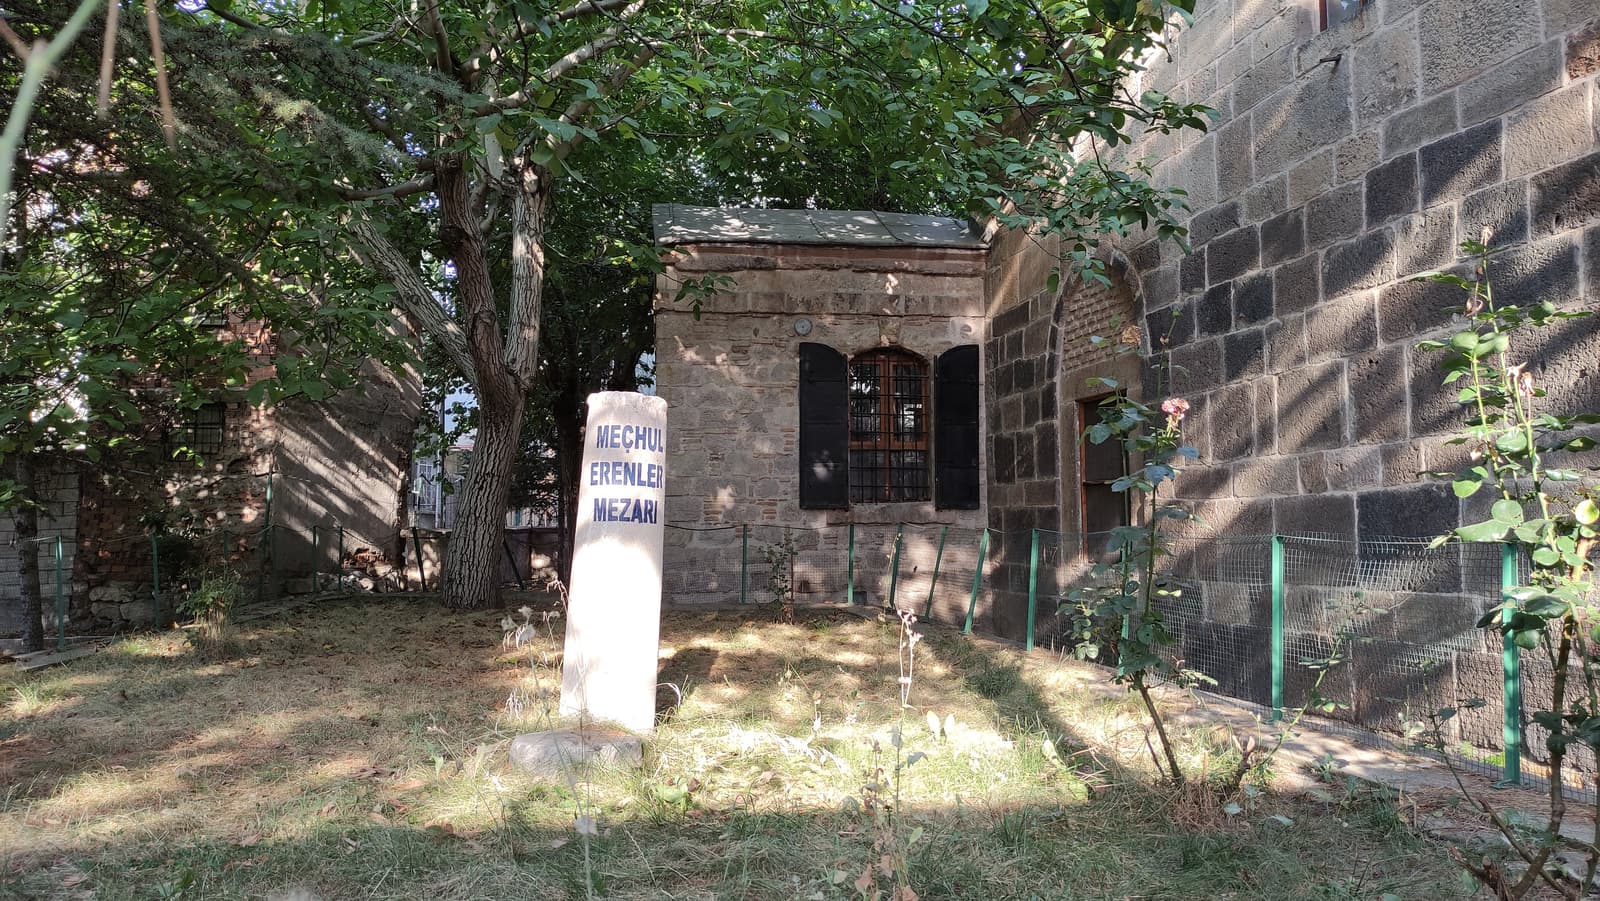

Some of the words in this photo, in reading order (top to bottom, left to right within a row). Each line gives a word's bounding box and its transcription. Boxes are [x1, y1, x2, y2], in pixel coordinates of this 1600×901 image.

[596, 424, 664, 453] MEÇHUL
[590, 461, 663, 489] ERENLER
[593, 498, 658, 524] MEZARI
